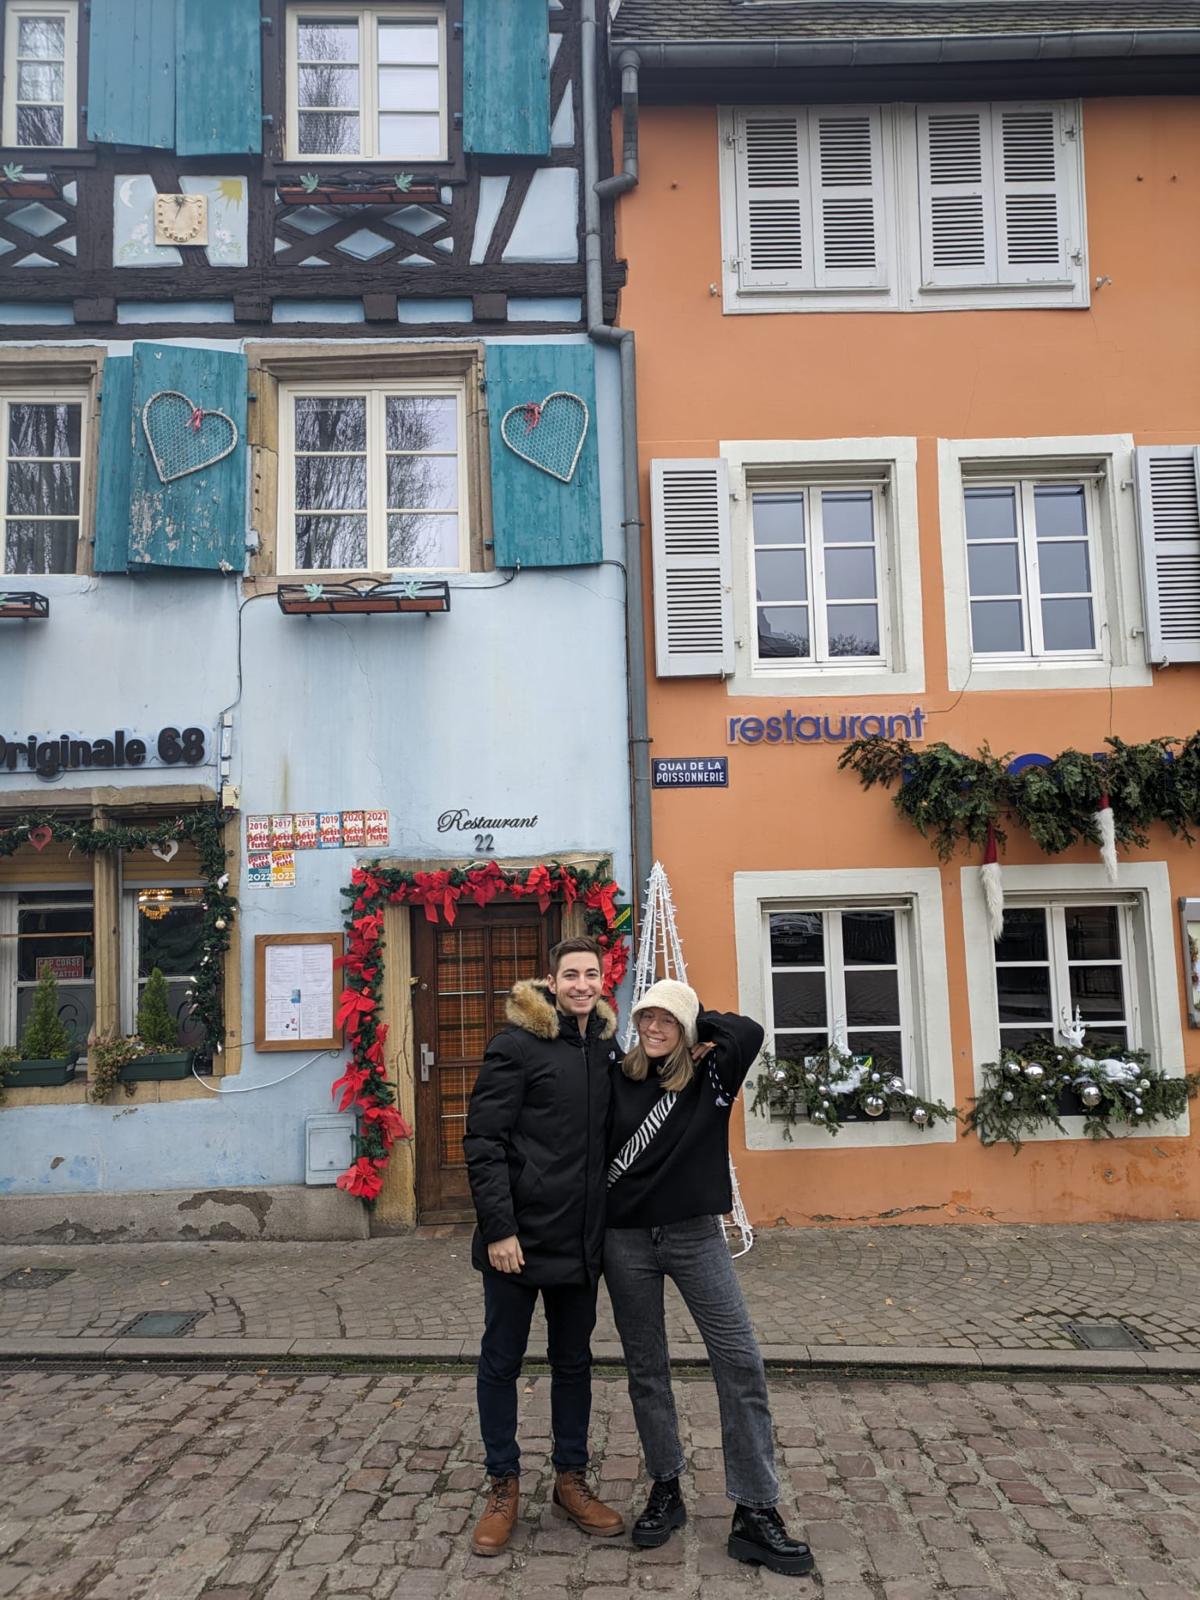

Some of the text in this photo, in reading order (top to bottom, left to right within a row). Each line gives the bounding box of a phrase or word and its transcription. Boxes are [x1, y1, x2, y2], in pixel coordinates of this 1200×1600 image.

[729, 707, 926, 743] restaurant
[0, 727, 205, 777] riginale 68
[658, 761, 721, 771] QUAI DE LA
[656, 772, 725, 783] POISSONNERIE
[321, 815, 339, 824] 2019
[343, 813, 363, 822] 2020
[367, 812, 387, 821] 2021
[437, 808, 539, 833] Restaurant
[249, 822, 268, 830] 2016
[274, 820, 291, 828] 2017
[298, 819, 315, 827] 2018
[474, 834, 495, 852] 22
[248, 873, 271, 881] 2022
[272, 872, 295, 880] 2023
[55, 958, 81, 967] CORSE
